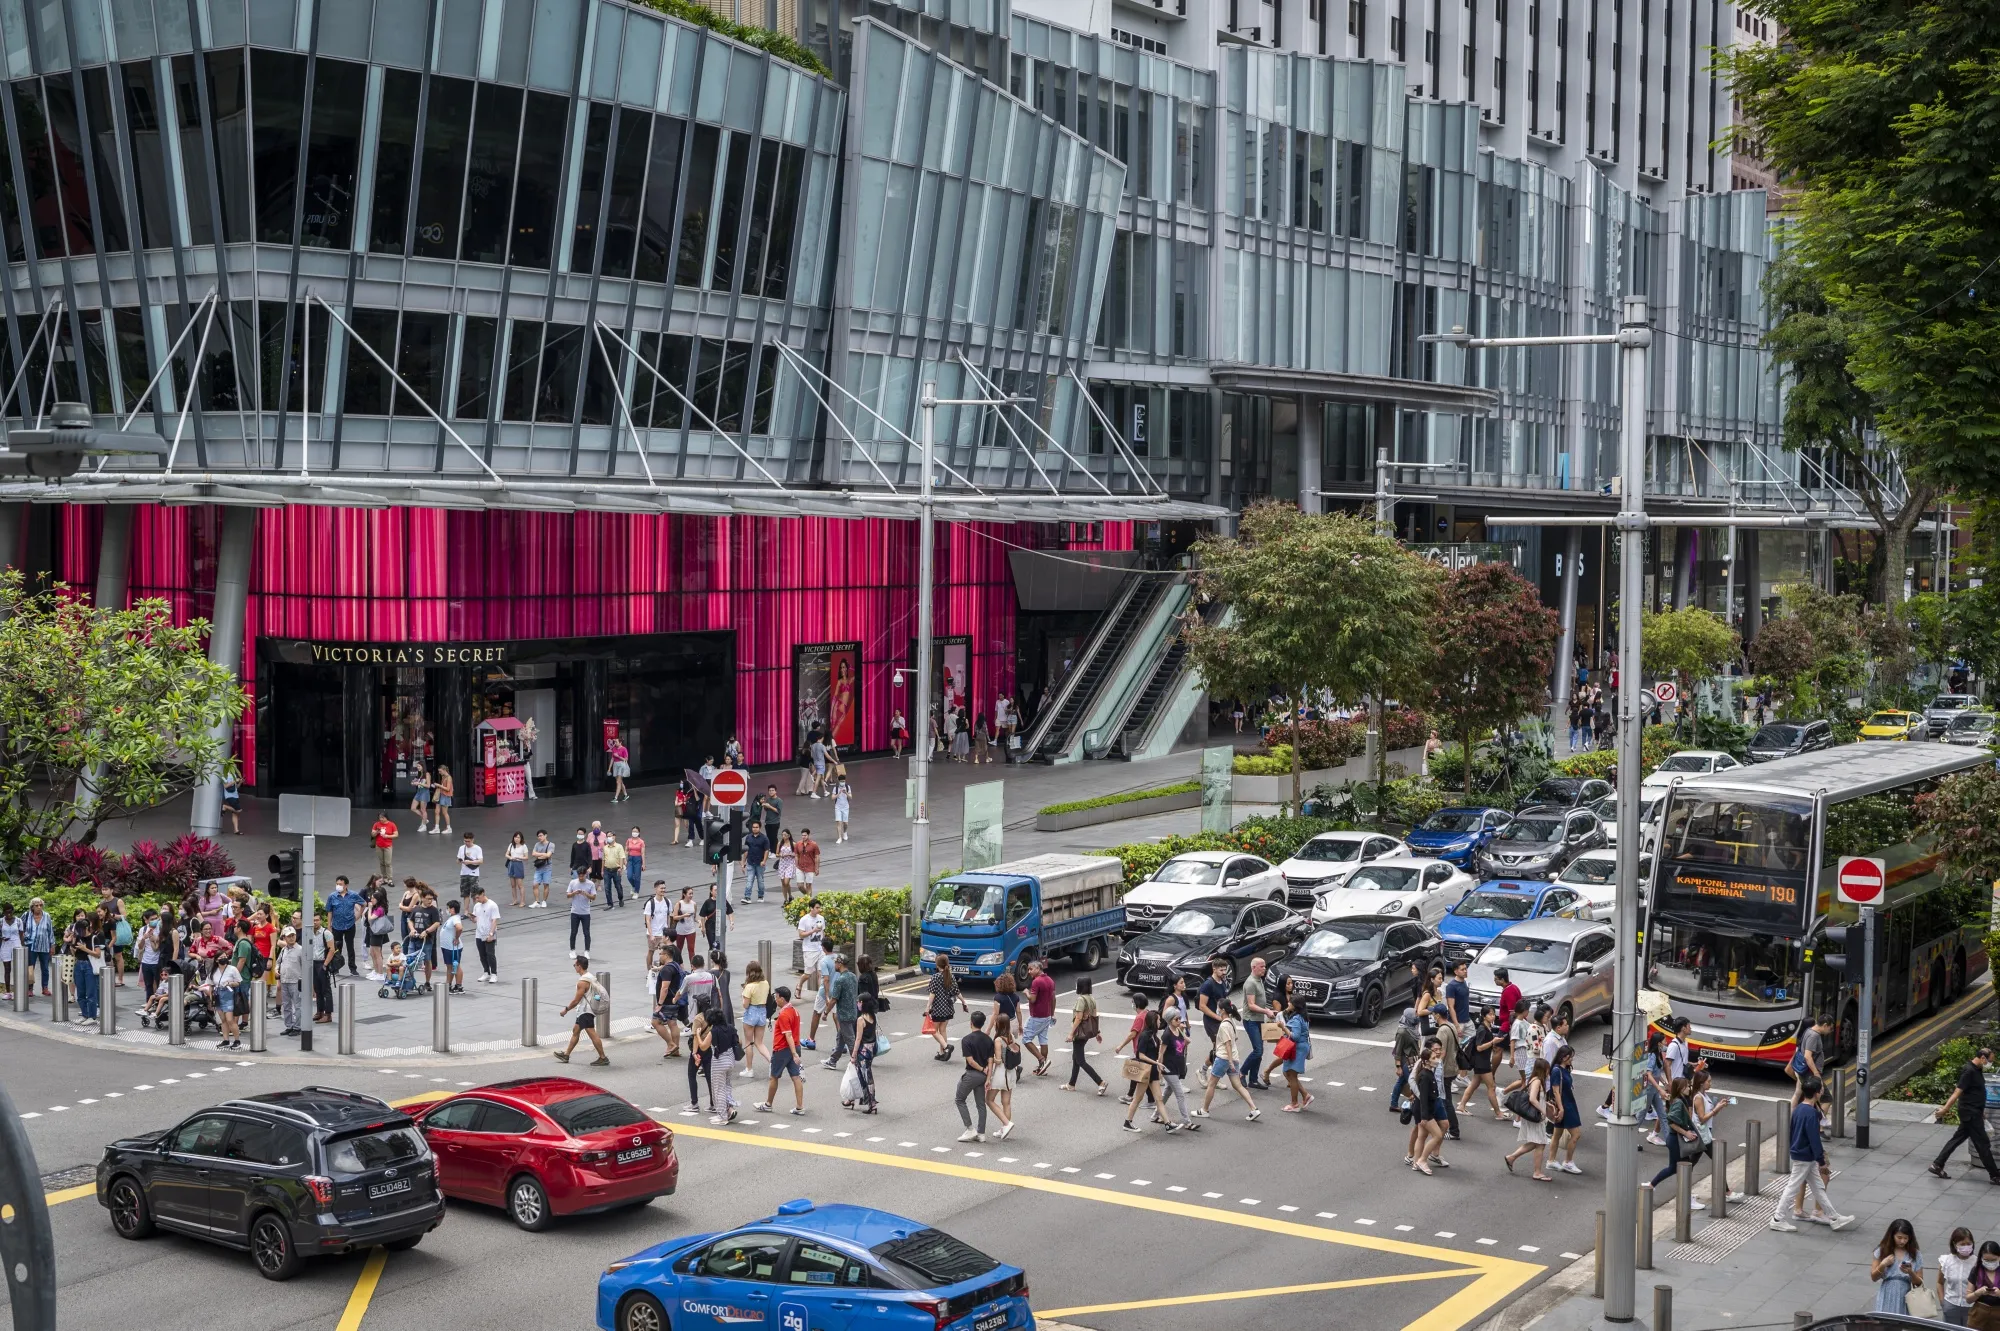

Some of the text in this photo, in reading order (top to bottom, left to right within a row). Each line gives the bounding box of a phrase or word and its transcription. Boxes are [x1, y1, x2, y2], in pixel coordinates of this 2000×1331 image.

[312, 645, 505, 663] VICTORIA'S SECRET
[834, 643, 856, 652] SECRET
[1696, 885, 1746, 898] TERMINAL
[1770, 885, 1796, 903] 190
[617, 1147, 652, 1162] SLC8526P
[371, 1180, 409, 1197] SLC1048Z
[783, 1310, 803, 1331] zig
